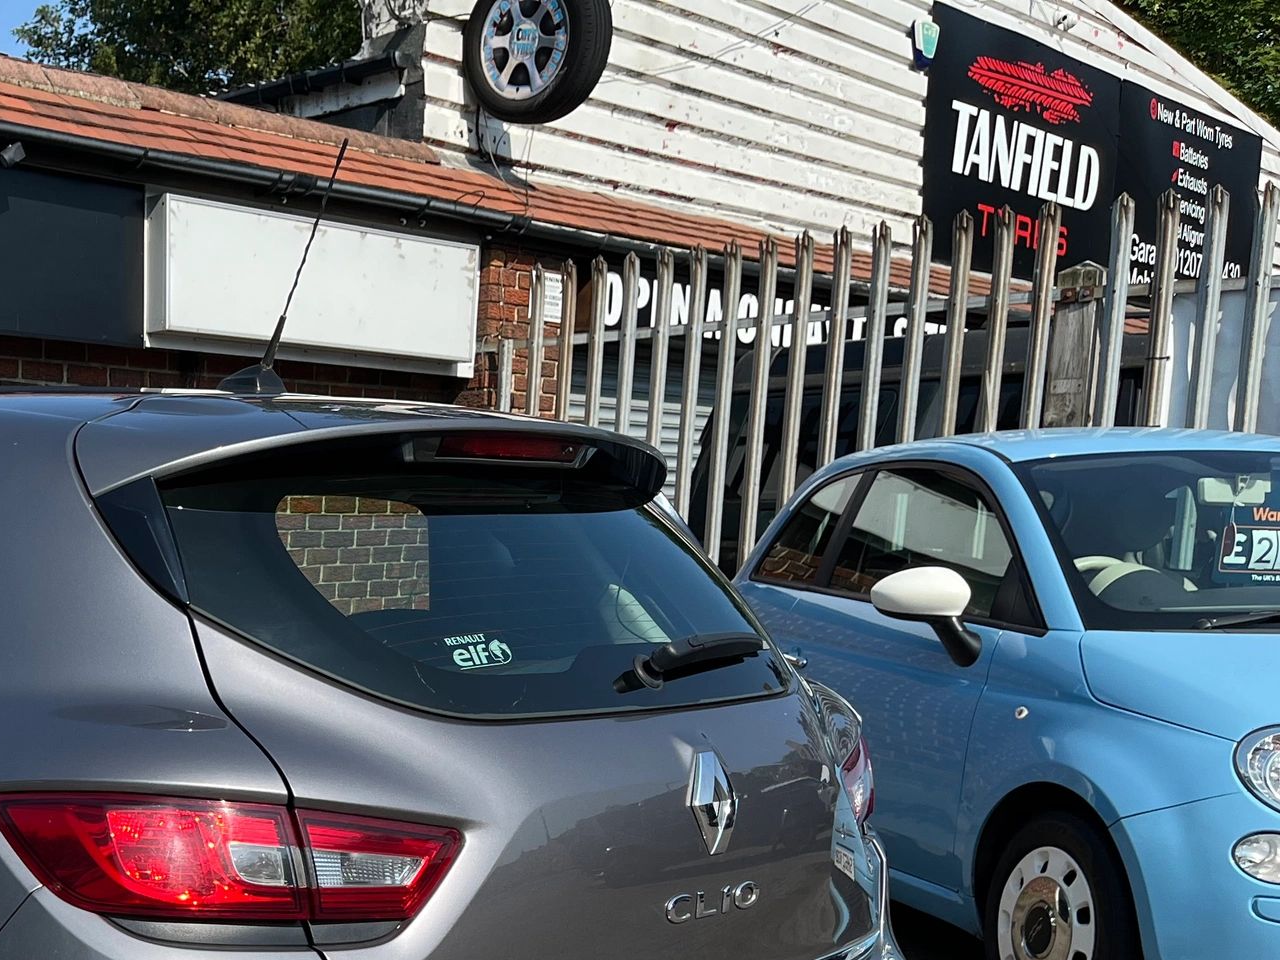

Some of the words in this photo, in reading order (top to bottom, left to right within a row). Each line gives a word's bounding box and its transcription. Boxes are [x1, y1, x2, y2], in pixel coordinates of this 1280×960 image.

[1157, 102, 1173, 126] New
[1174, 109, 1181, 128] &
[1181, 112, 1196, 135] Part
[1196, 119, 1214, 142] Worn
[1215, 126, 1233, 149] Tyres
[951, 99, 1100, 212] TANFIELD
[1180, 142, 1209, 170] Batteries
[1177, 168, 1208, 196] Exhausts
[1177, 193, 1206, 225] ervicing
[443, 633, 486, 646] RENAULT
[452, 643, 489, 667] elf
[665, 880, 761, 924] CLIO
